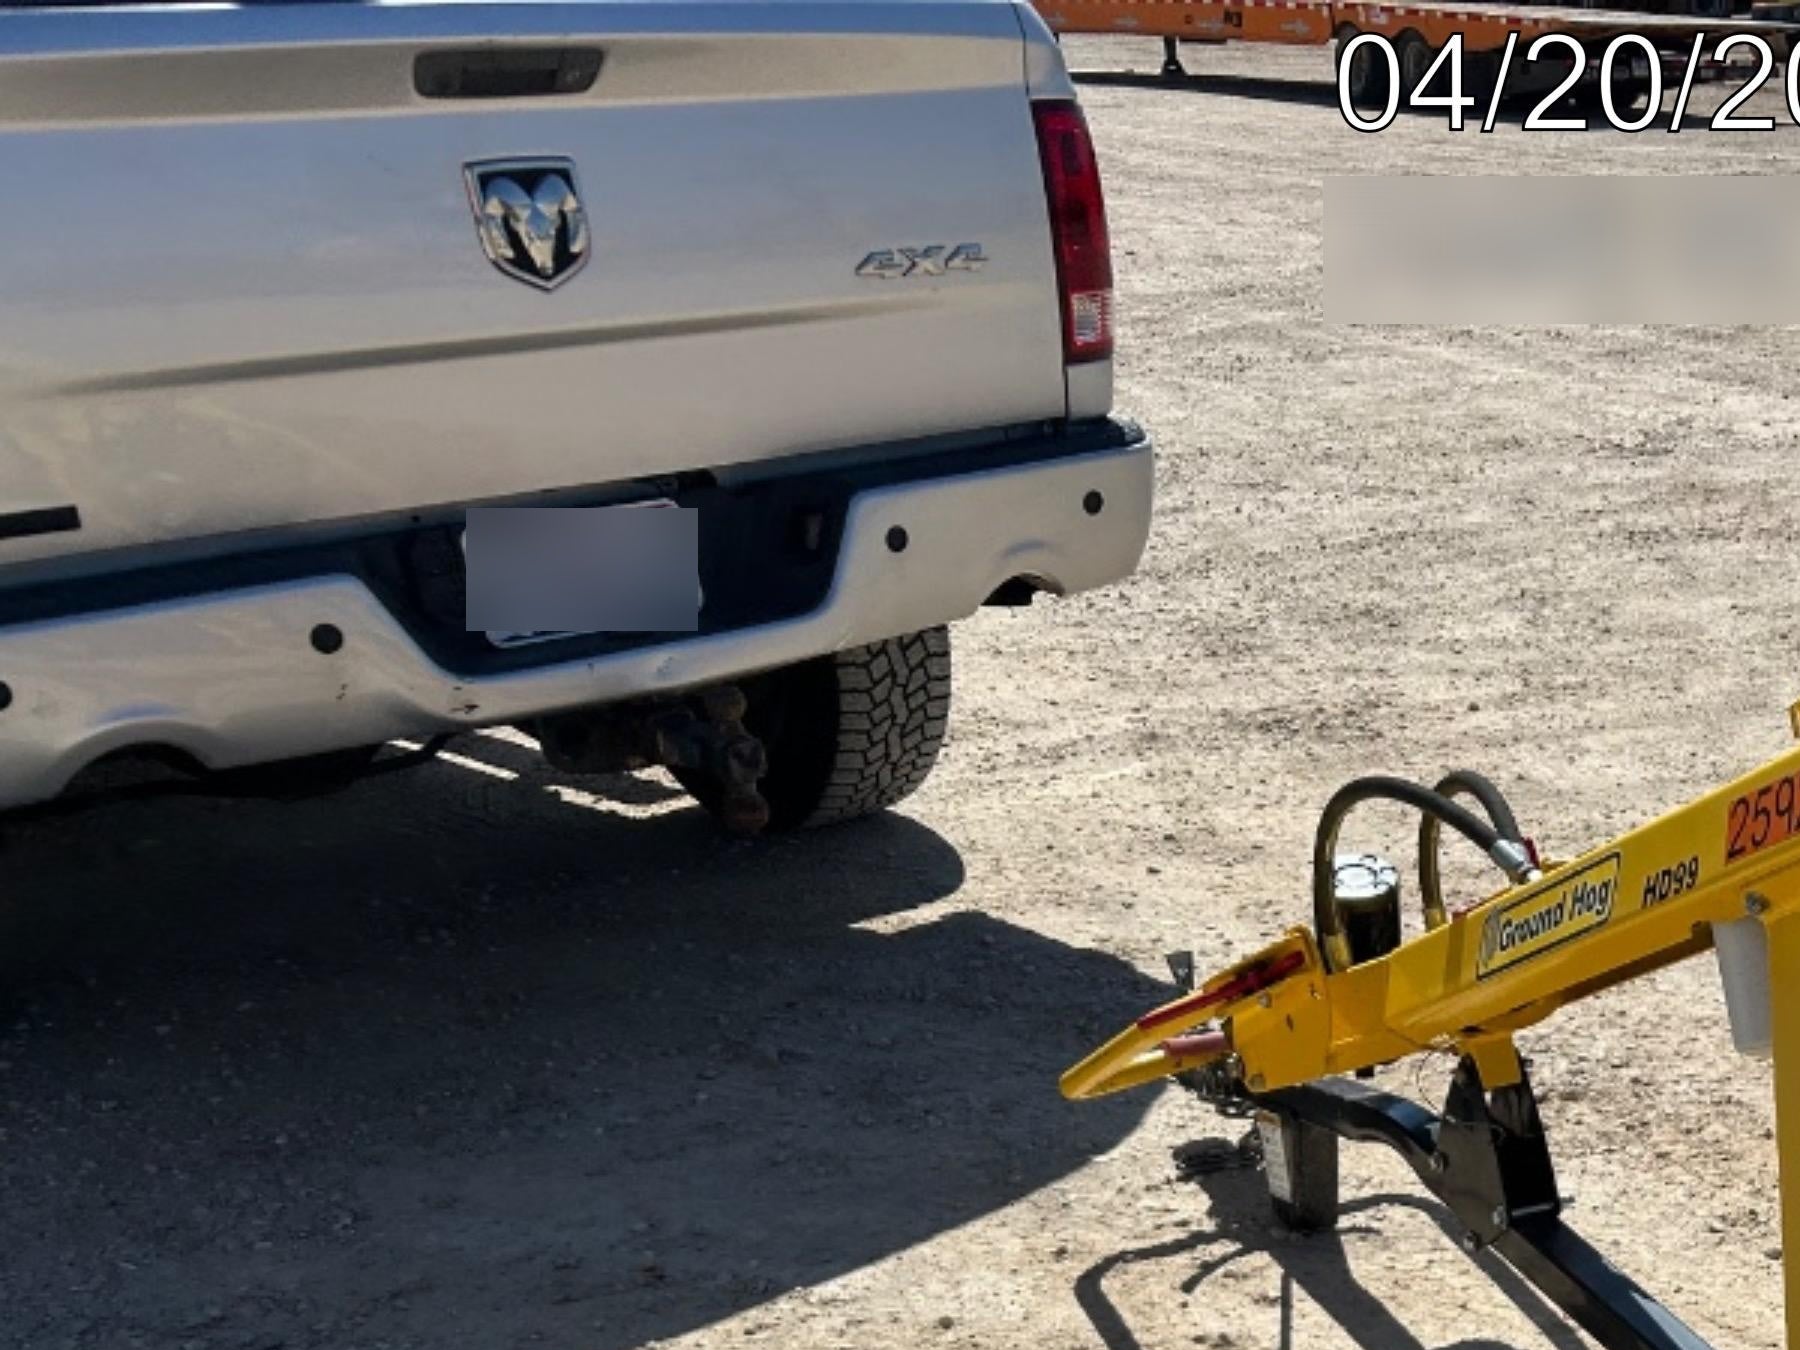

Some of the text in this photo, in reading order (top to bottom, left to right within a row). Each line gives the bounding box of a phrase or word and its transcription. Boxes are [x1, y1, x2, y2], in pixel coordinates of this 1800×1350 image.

[1641, 855, 1699, 909] HD99
[1499, 877, 1613, 952] Ground Hog
